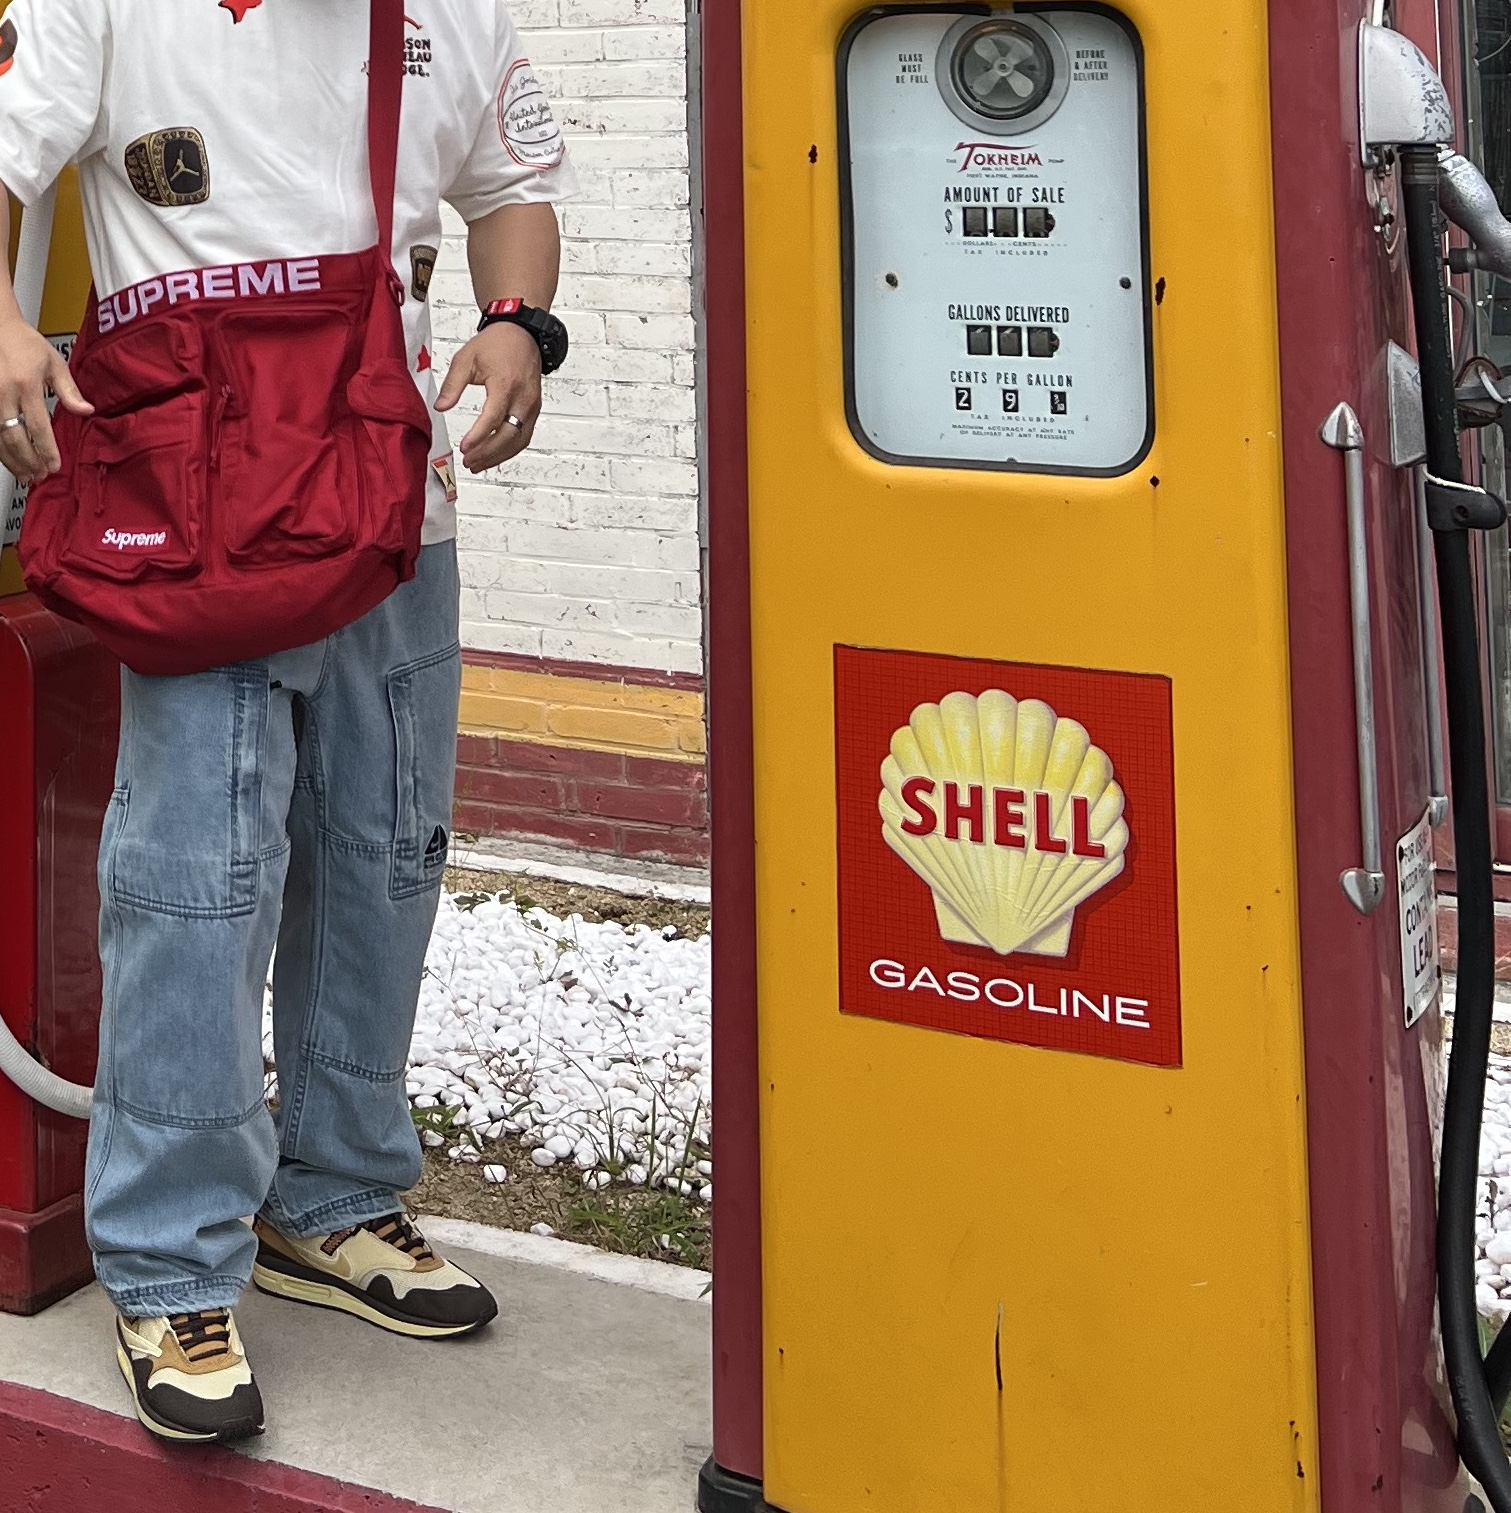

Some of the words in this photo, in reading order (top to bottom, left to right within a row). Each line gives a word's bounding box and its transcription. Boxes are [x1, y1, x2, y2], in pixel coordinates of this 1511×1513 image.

[406, 37, 431, 50] SON
[898, 53, 923, 63] GLASS
[1084, 61, 1108, 70] AFTER
[901, 64, 922, 73] MUST
[1073, 72, 1109, 82] DELIVERY
[910, 75, 929, 84] FULL
[953, 142, 1044, 173] TOKHEIM
[944, 187, 999, 203] AMOUNT
[1007, 187, 1023, 203] OF
[1032, 187, 1065, 203] SALE
[97, 258, 321, 334] SUPREME
[948, 304, 1001, 321] GALLONS
[1005, 306, 1070, 323] DELIVERED
[950, 370, 988, 384] CENTS
[996, 372, 1017, 385] PER
[1027, 373, 1073, 387] GALLON
[958, 389, 969, 407] 2
[1005, 392, 1017, 410] 9
[102, 528, 166, 550] Supreme
[900, 775, 1106, 859] SHELL
[869, 959, 1151, 1029] GASOLINE
